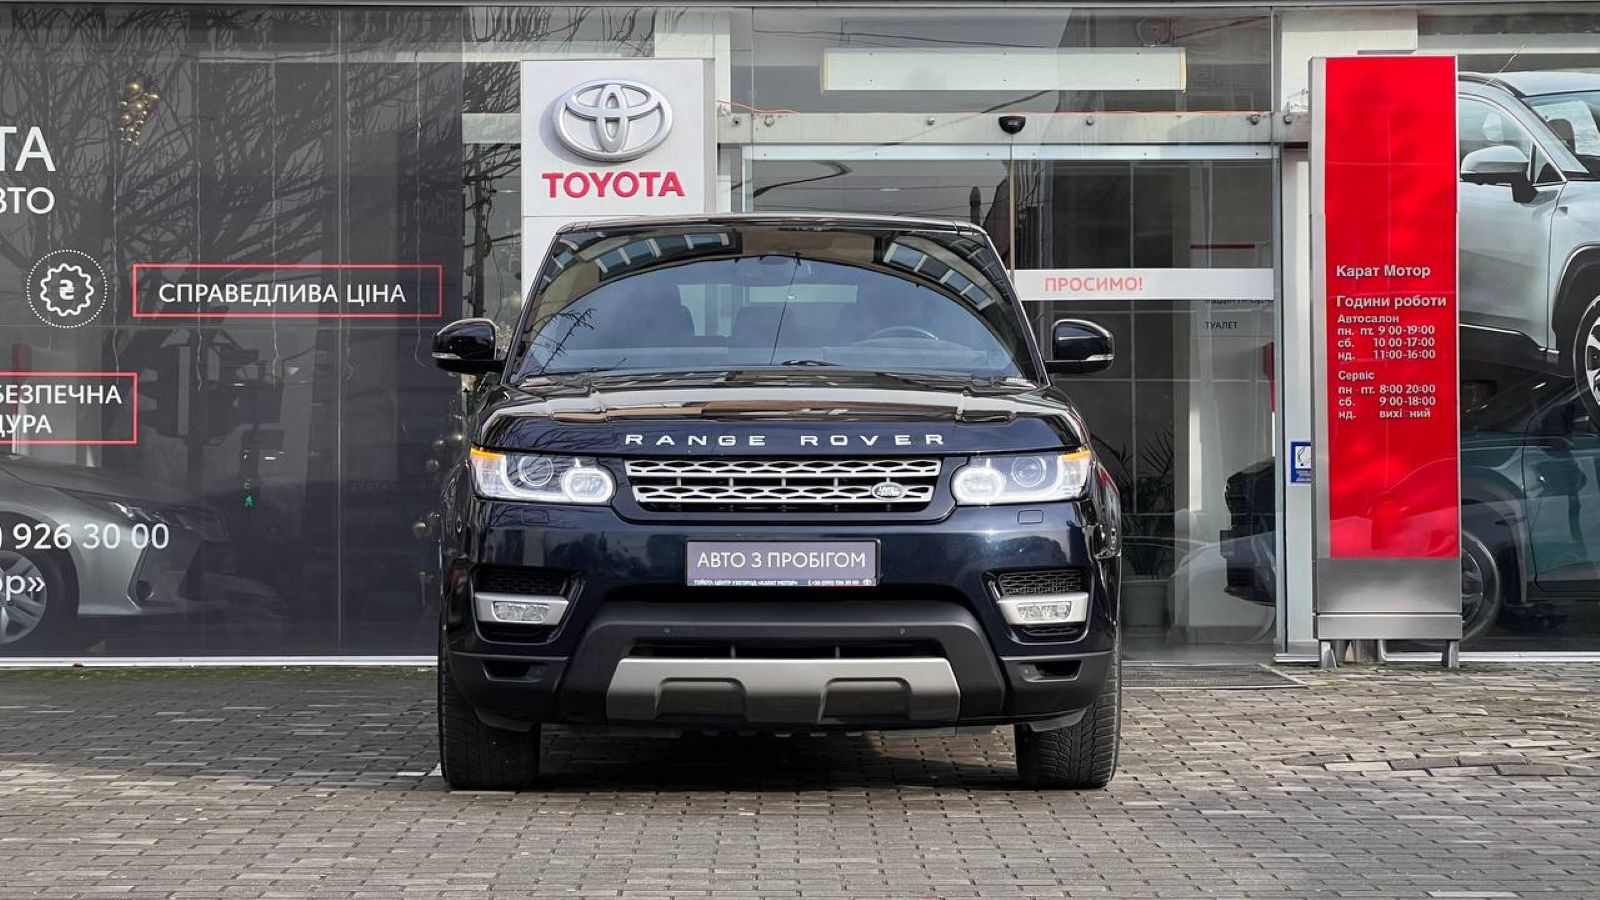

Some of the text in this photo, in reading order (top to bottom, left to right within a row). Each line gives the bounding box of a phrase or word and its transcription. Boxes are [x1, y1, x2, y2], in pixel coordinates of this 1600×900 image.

[541, 171, 685, 199] TOYOTA
[1336, 264, 1431, 280] Карат Мотор
[1044, 276, 1145, 292] ПРОСИМО!
[158, 283, 407, 306] СПРАВЕДЛИВА ЦІНА
[1336, 295, 1447, 310] Години роботи
[1205, 320, 1238, 329] ТУАЛЕТ
[1337, 314, 1400, 324] Автосалон
[1337, 338, 1355, 348] сб.
[1338, 351, 1356, 361] нд.
[1338, 370, 1375, 382] Сервіс
[0, 384, 122, 405] ЕЗПЕЧНА
[1338, 396, 1355, 407] сб.
[624, 433, 945, 447] RANGE ROVER
[12, 522, 73, 550] 926
[82, 522, 121, 550] 30
[130, 522, 170, 550] 00
[697, 551, 746, 568] АВТО
[767, 551, 867, 568] ПРОБІГОМ
